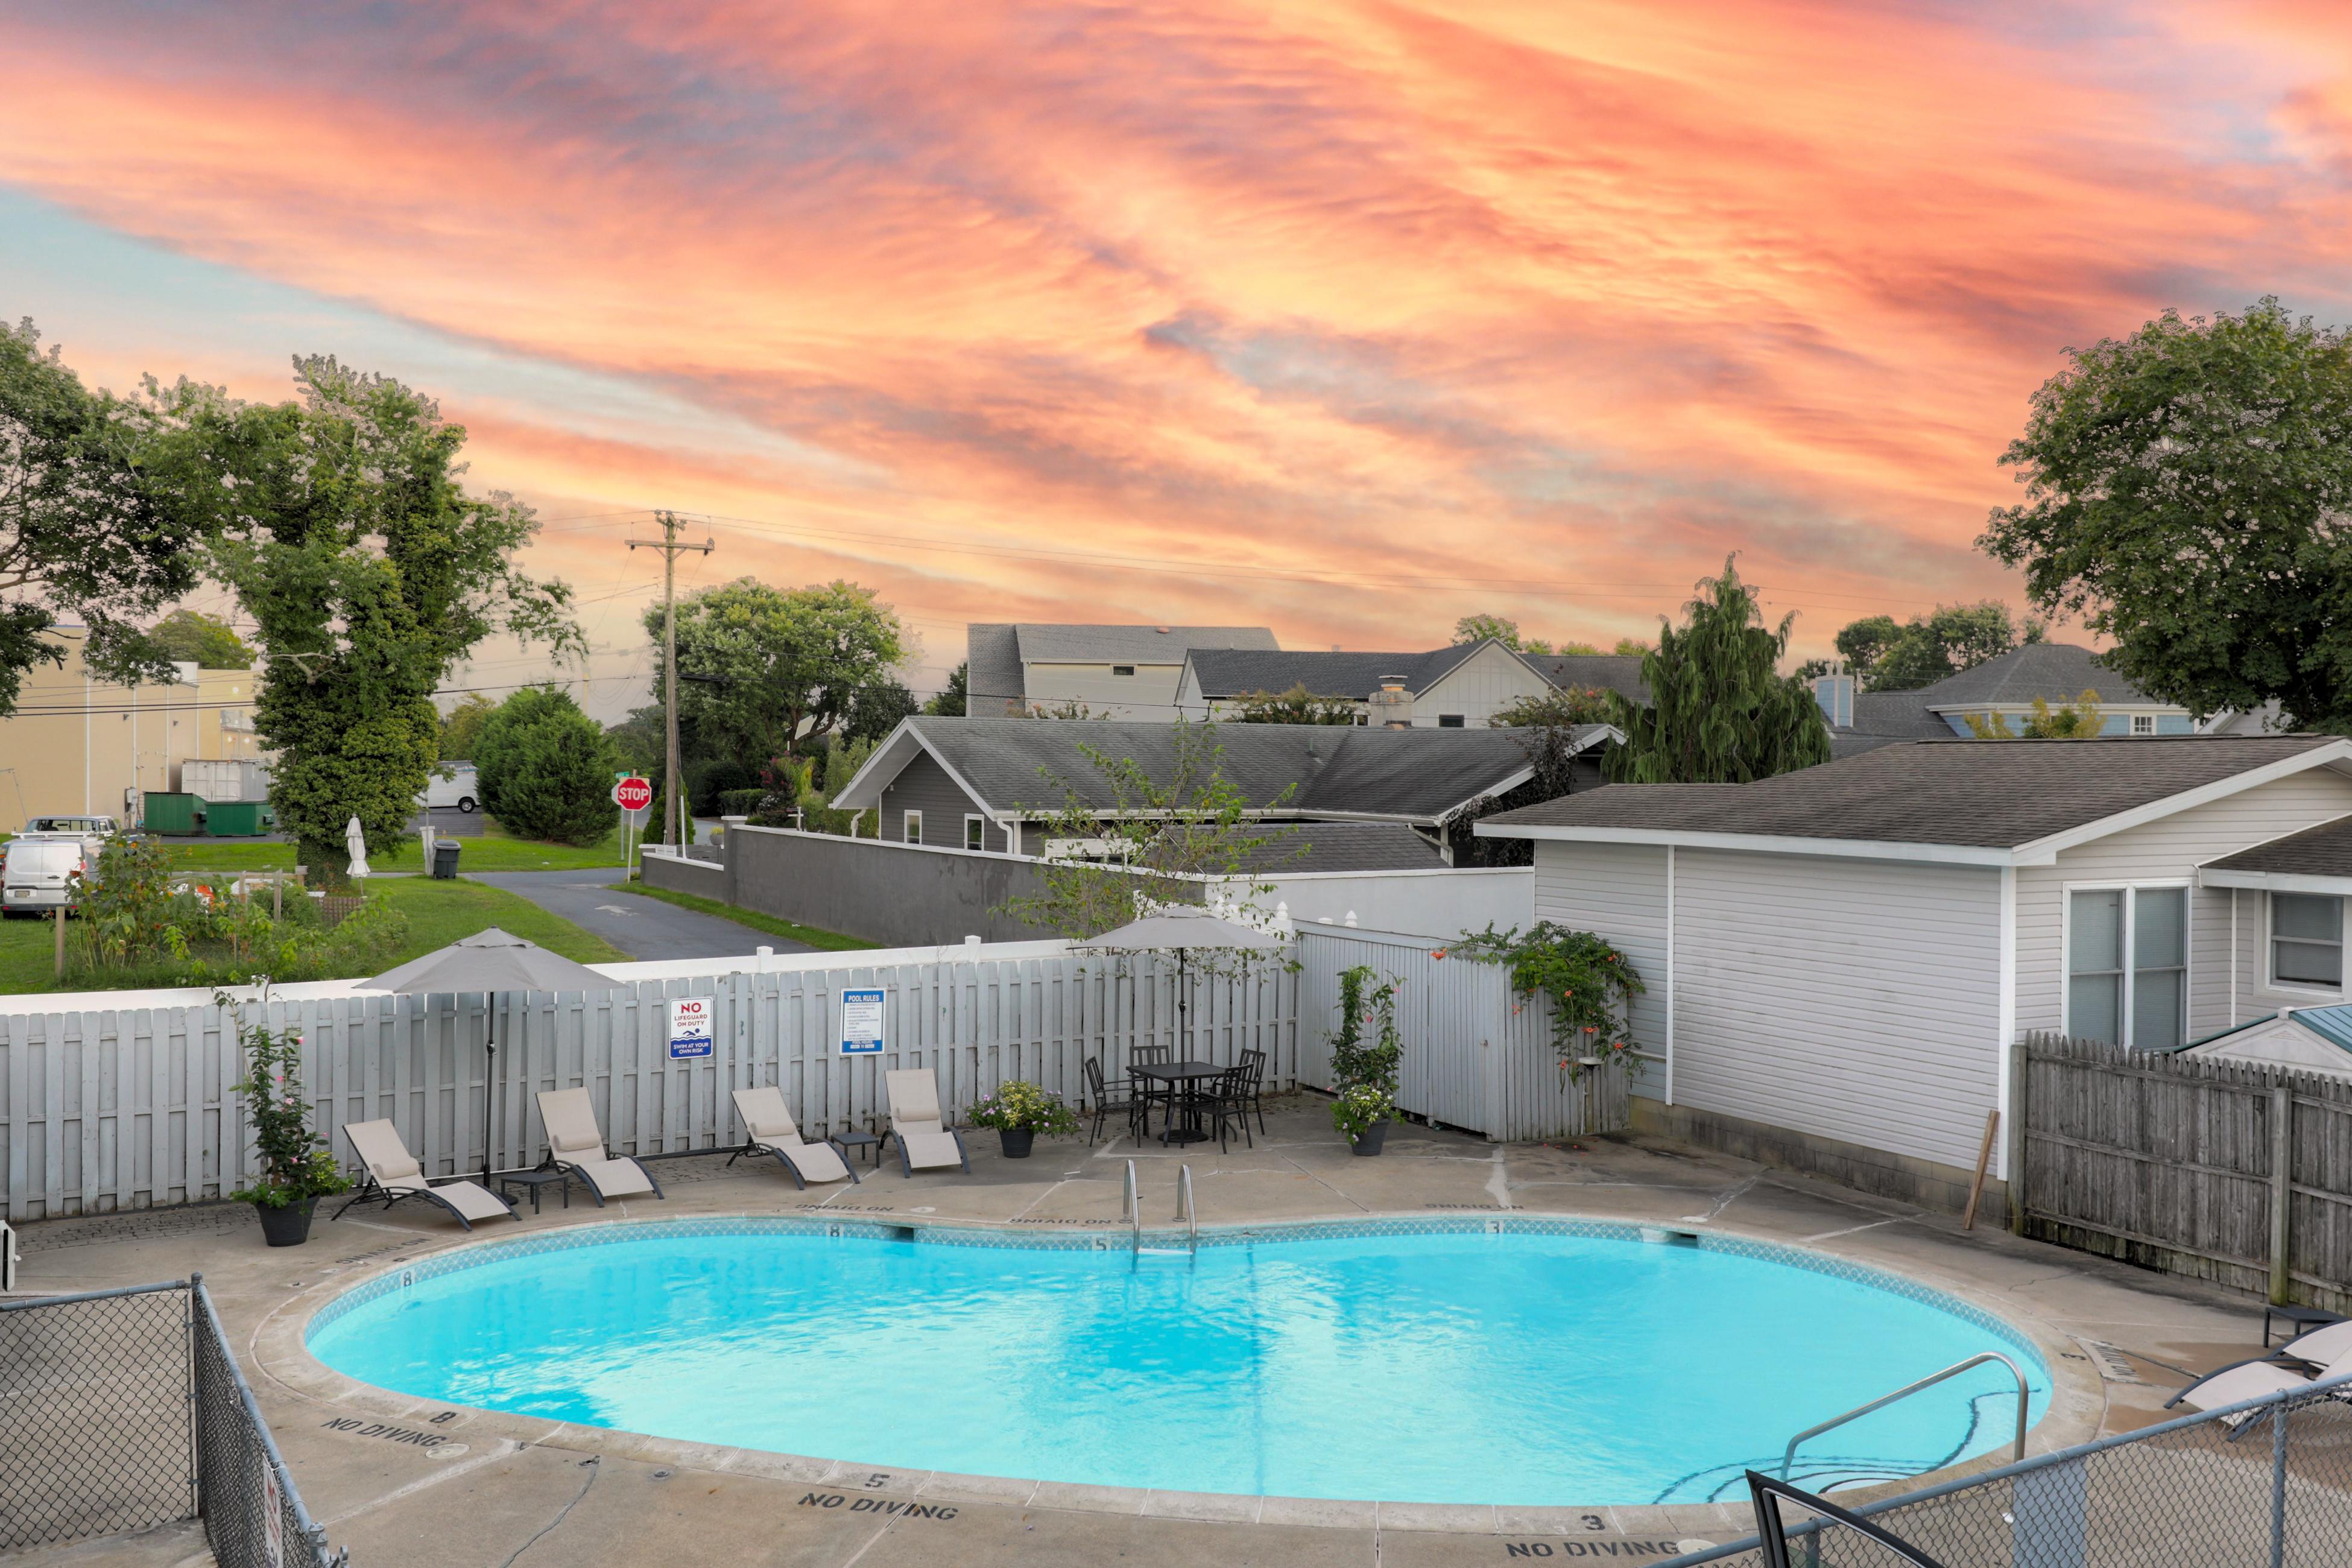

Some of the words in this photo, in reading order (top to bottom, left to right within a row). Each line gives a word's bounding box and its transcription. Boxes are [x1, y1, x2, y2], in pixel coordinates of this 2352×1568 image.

[619, 787, 649, 801] STOP
[681, 1002, 701, 1013] NO
[830, 1223, 840, 1237] 8
[400, 1238, 432, 1246] NO
[1096, 1237, 1107, 1251] 5
[335, 1246, 403, 1265] DIVING
[403, 1271, 412, 1287] 8
[429, 1411, 457, 1424] 8
[320, 1417, 364, 1431] NO
[356, 1424, 448, 1447] DIVING
[864, 1473, 891, 1488] 5
[797, 1492, 846, 1508] NO
[849, 1497, 959, 1520] DIVING
[1581, 1514, 1606, 1531] 3
[1505, 1542, 1554, 1558] NO
[1563, 1540, 1680, 1557] DIVING
